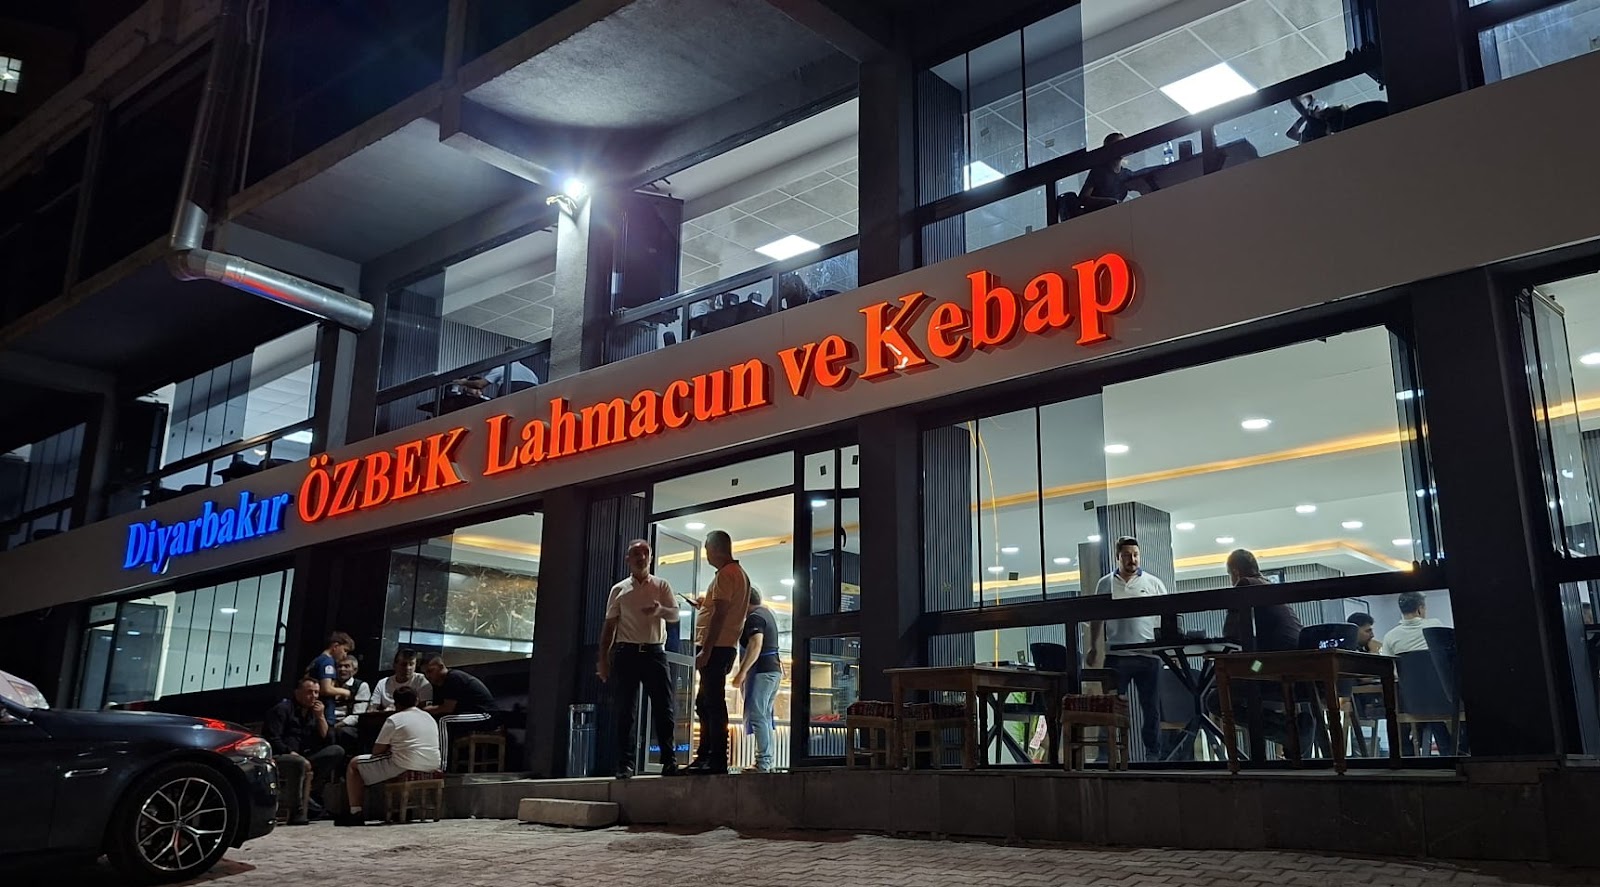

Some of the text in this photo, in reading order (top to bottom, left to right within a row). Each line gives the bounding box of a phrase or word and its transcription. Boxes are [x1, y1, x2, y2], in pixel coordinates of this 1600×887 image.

[123, 252, 1131, 574] Diyarbakır ÖZBEK Lahmacun ve Kebap
